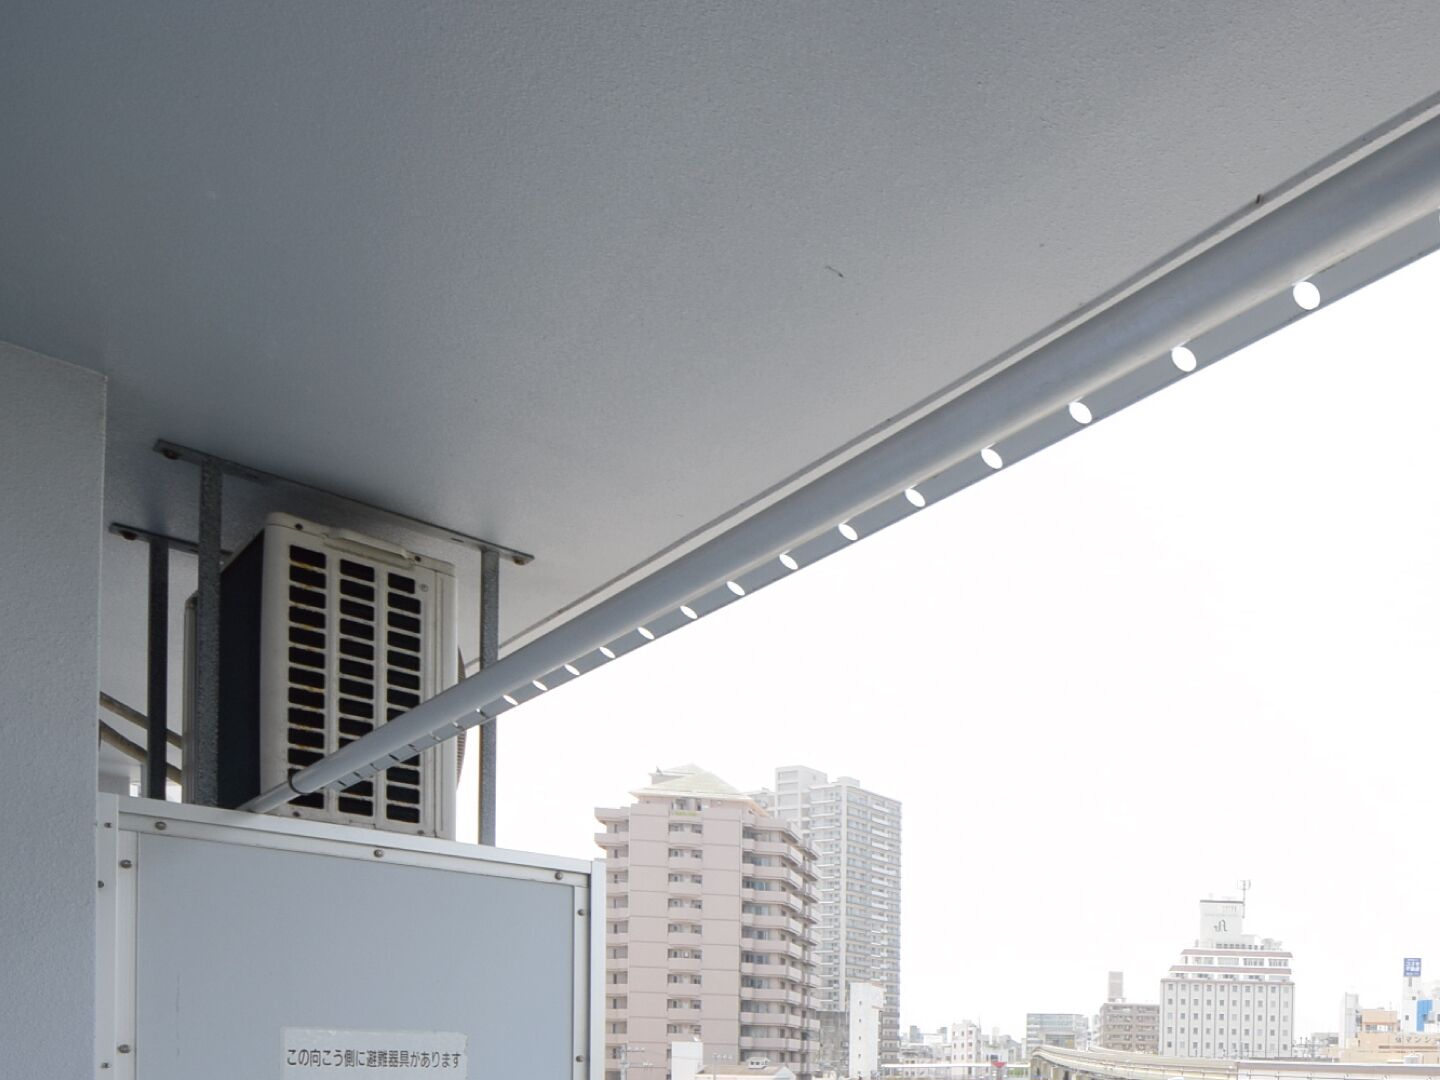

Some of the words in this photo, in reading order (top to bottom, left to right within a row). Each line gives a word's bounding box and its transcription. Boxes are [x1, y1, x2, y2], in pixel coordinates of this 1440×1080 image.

[286, 1049, 462, 1069] この向こう側に避難器具があります
